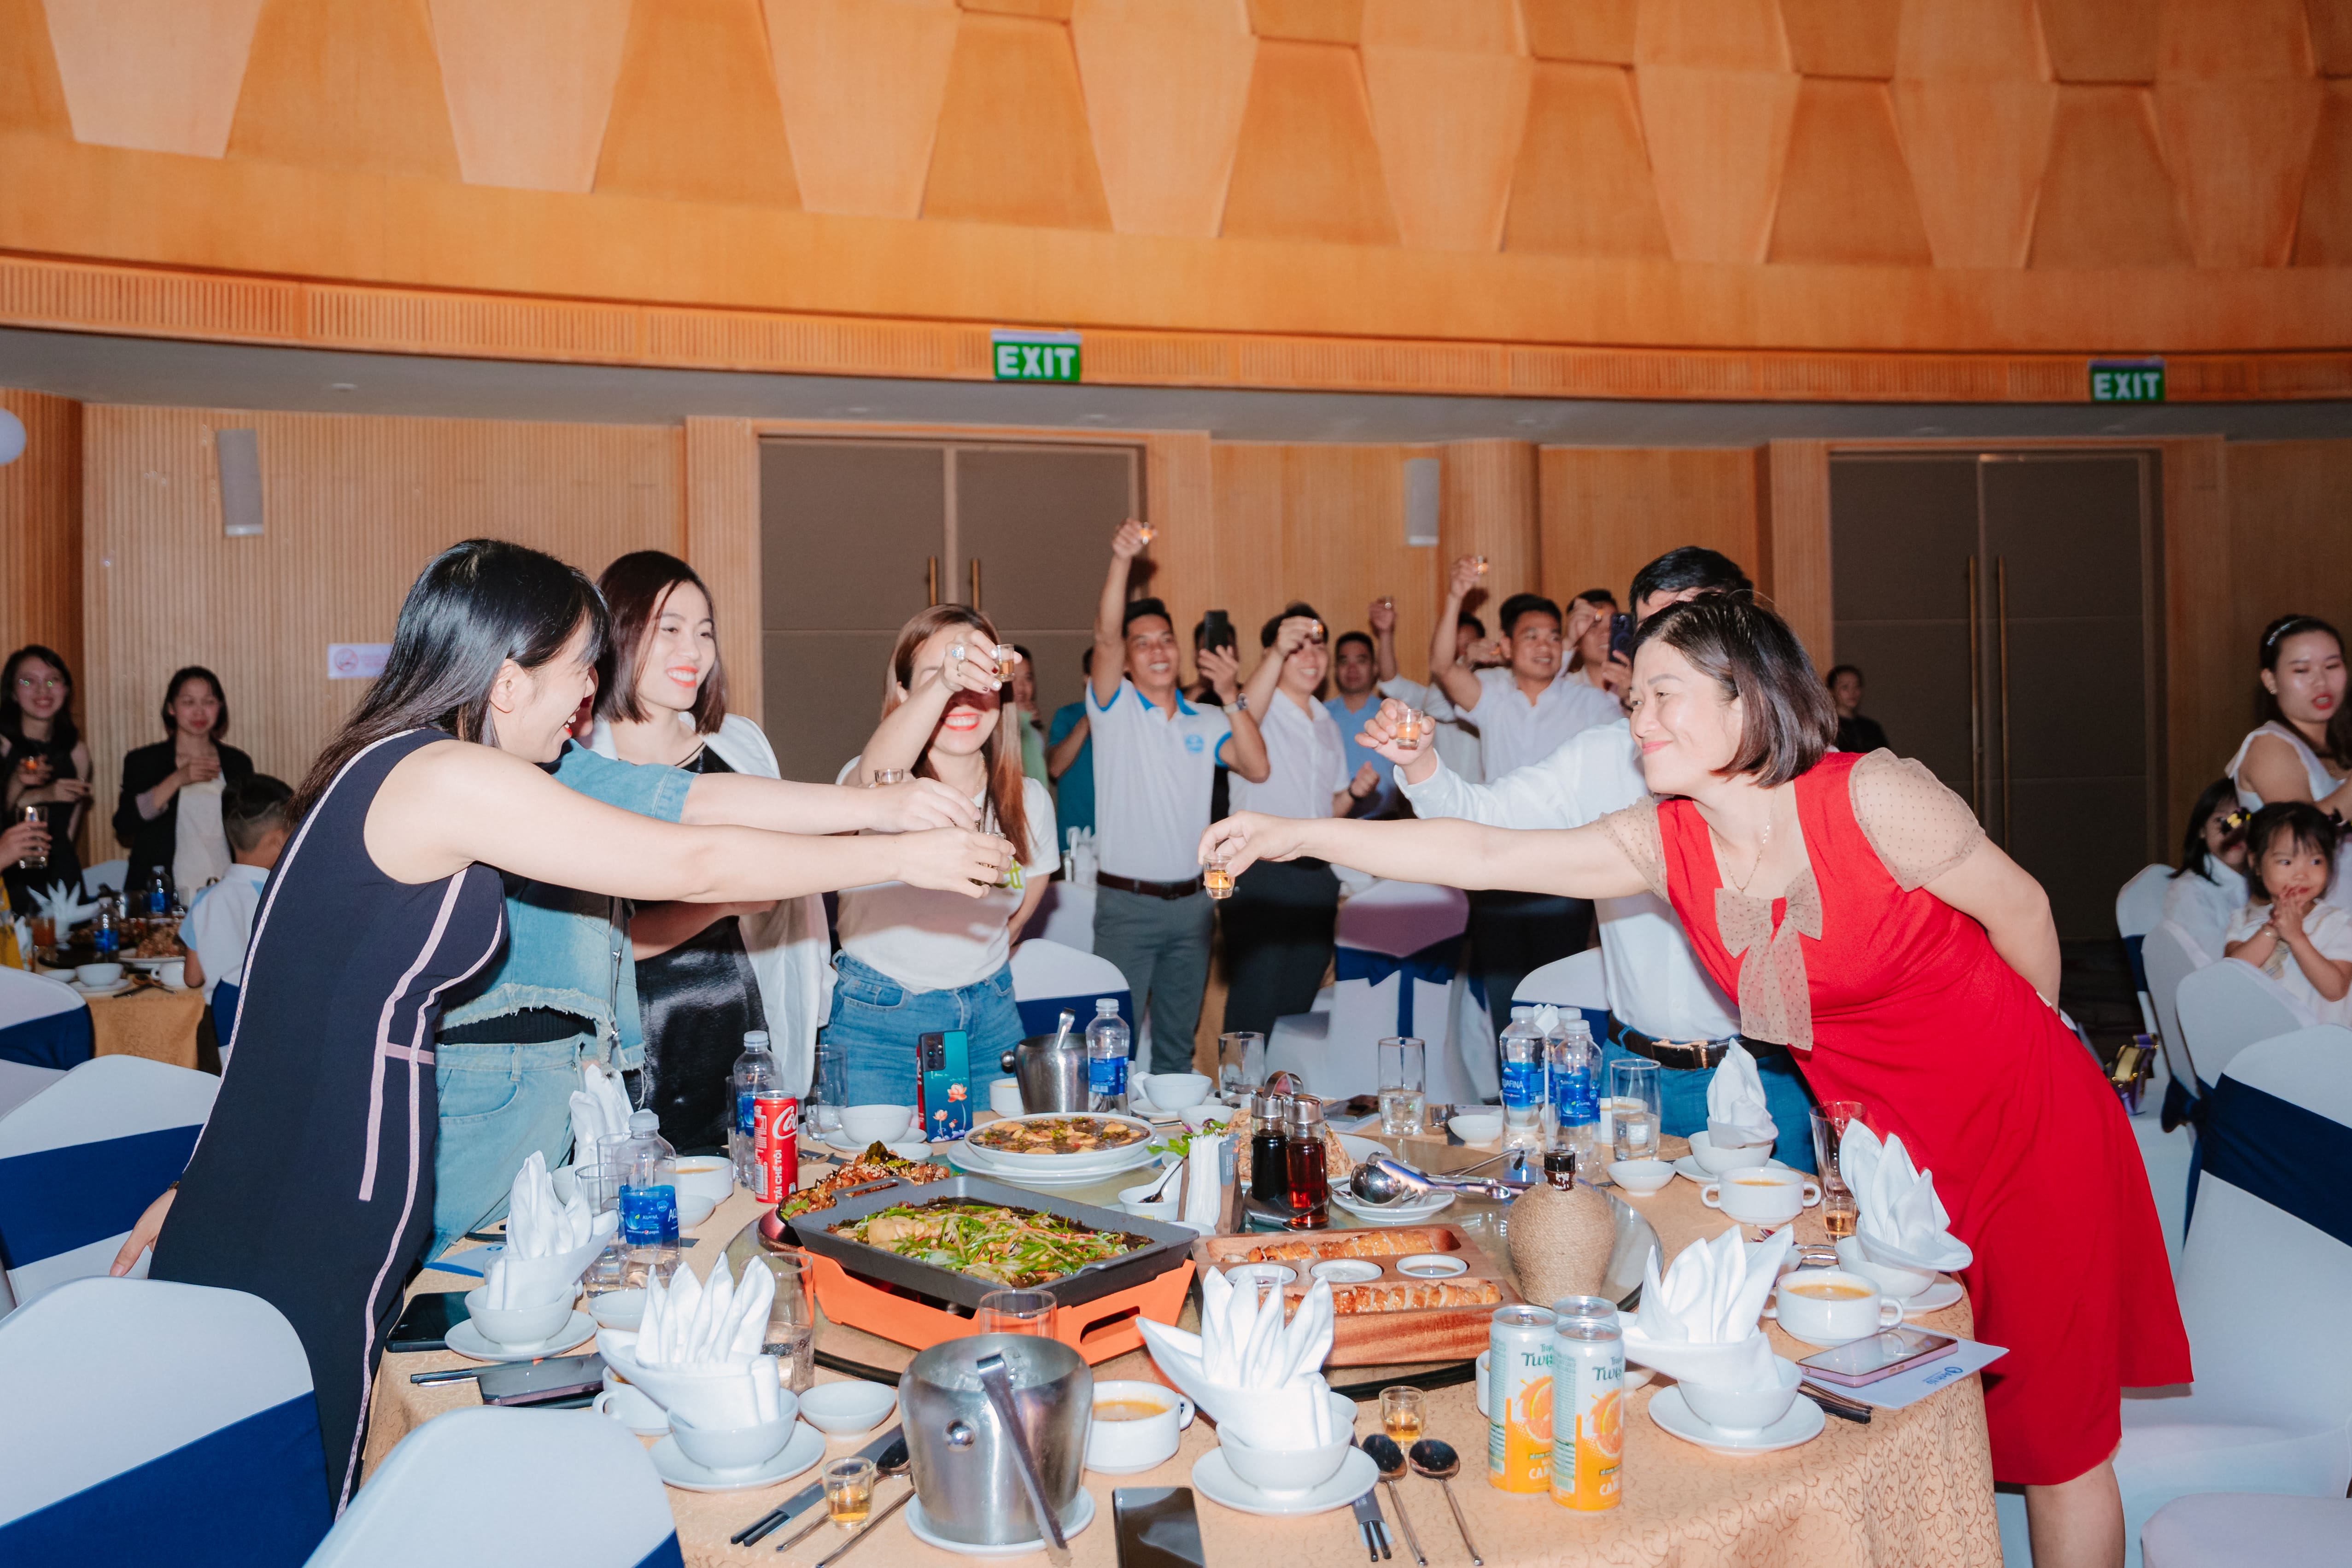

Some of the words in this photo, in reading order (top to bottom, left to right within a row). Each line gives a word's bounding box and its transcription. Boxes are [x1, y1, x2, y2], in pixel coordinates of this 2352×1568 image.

[997, 345, 1076, 377] EXIT
[2094, 372, 2160, 399] EXIT
[773, 1149, 782, 1164] TÔI
[772, 1165, 782, 1185] CHẾ
[773, 1186, 782, 1200] TÁI
